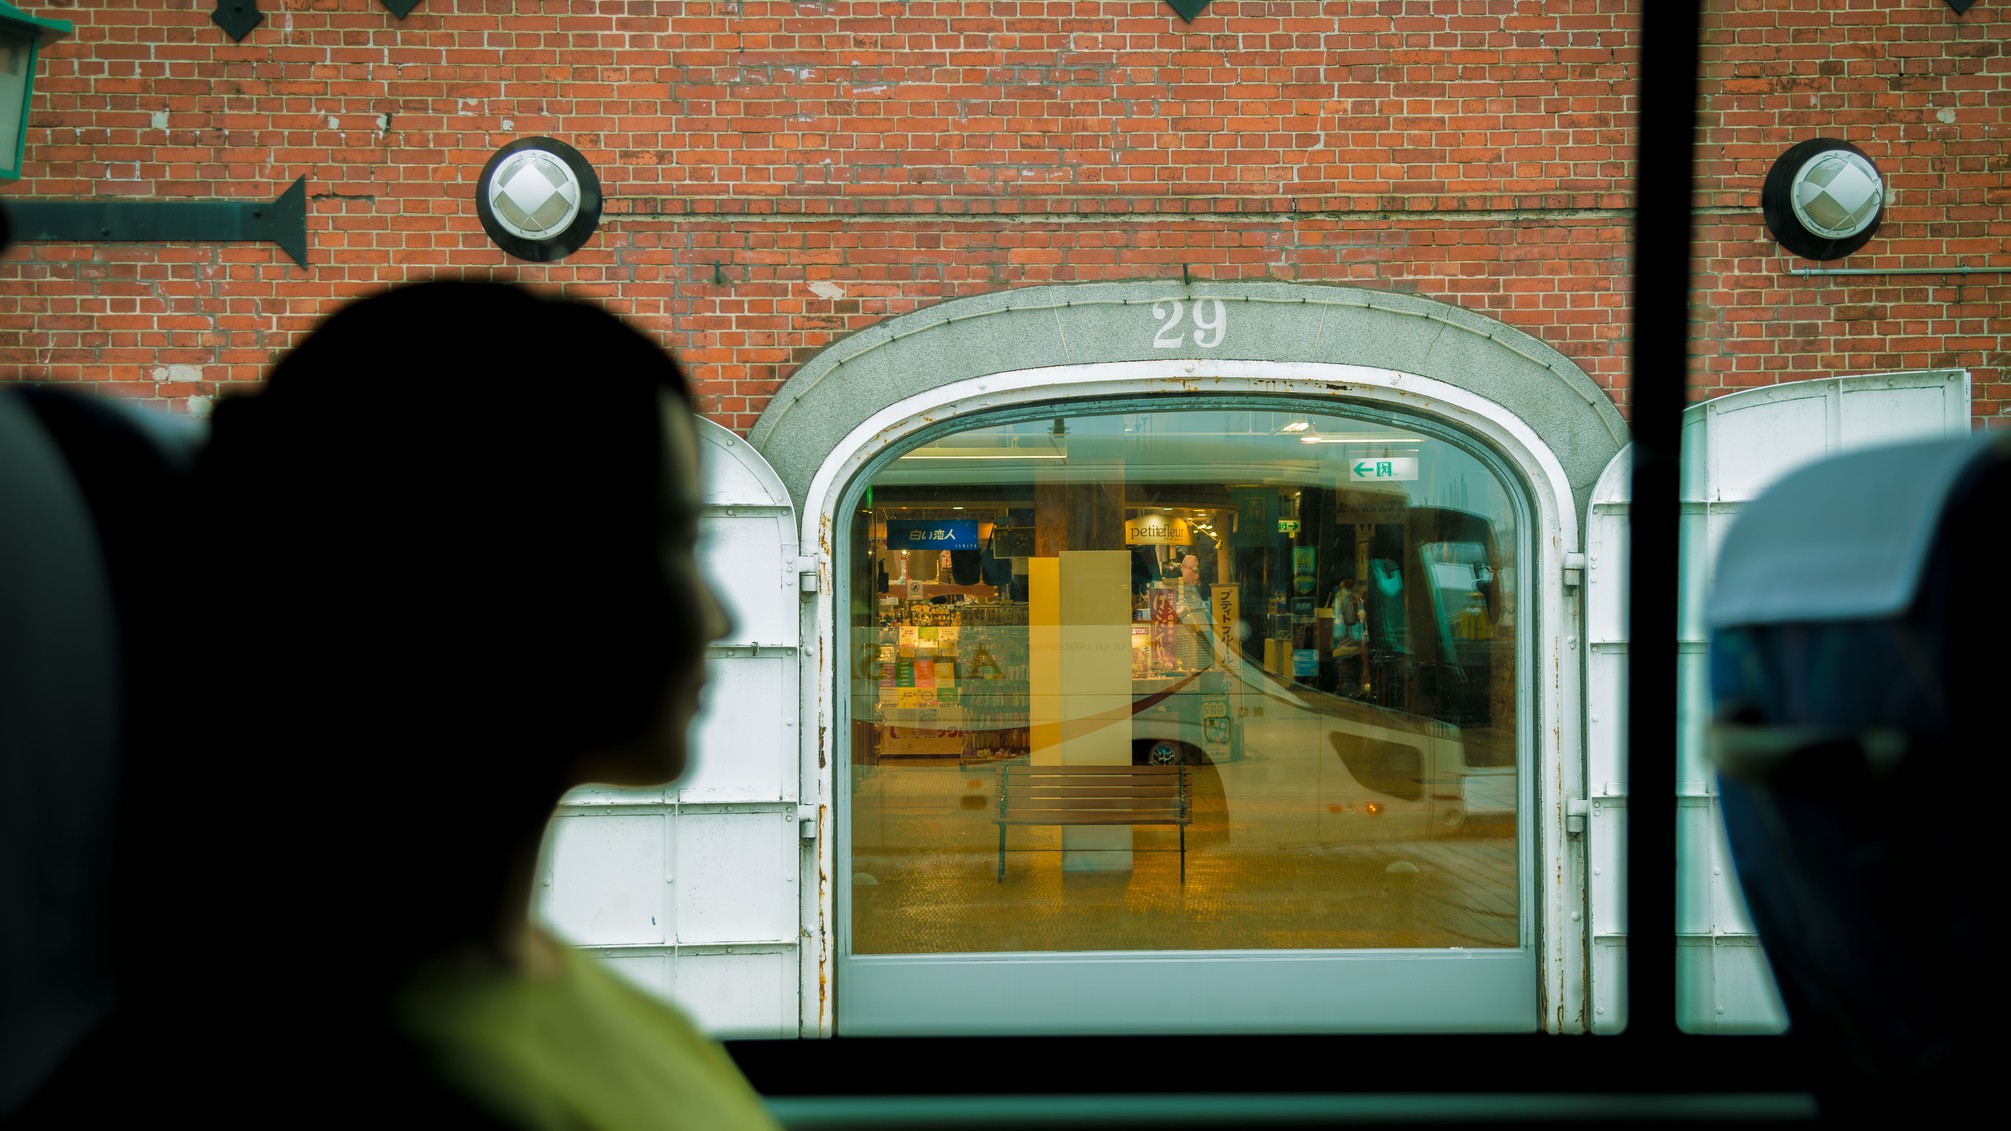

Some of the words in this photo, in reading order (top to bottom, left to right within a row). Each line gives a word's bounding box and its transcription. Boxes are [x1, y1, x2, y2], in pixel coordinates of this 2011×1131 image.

[1152, 299, 1227, 349] 29
[909, 529, 956, 540] 白い恋人
